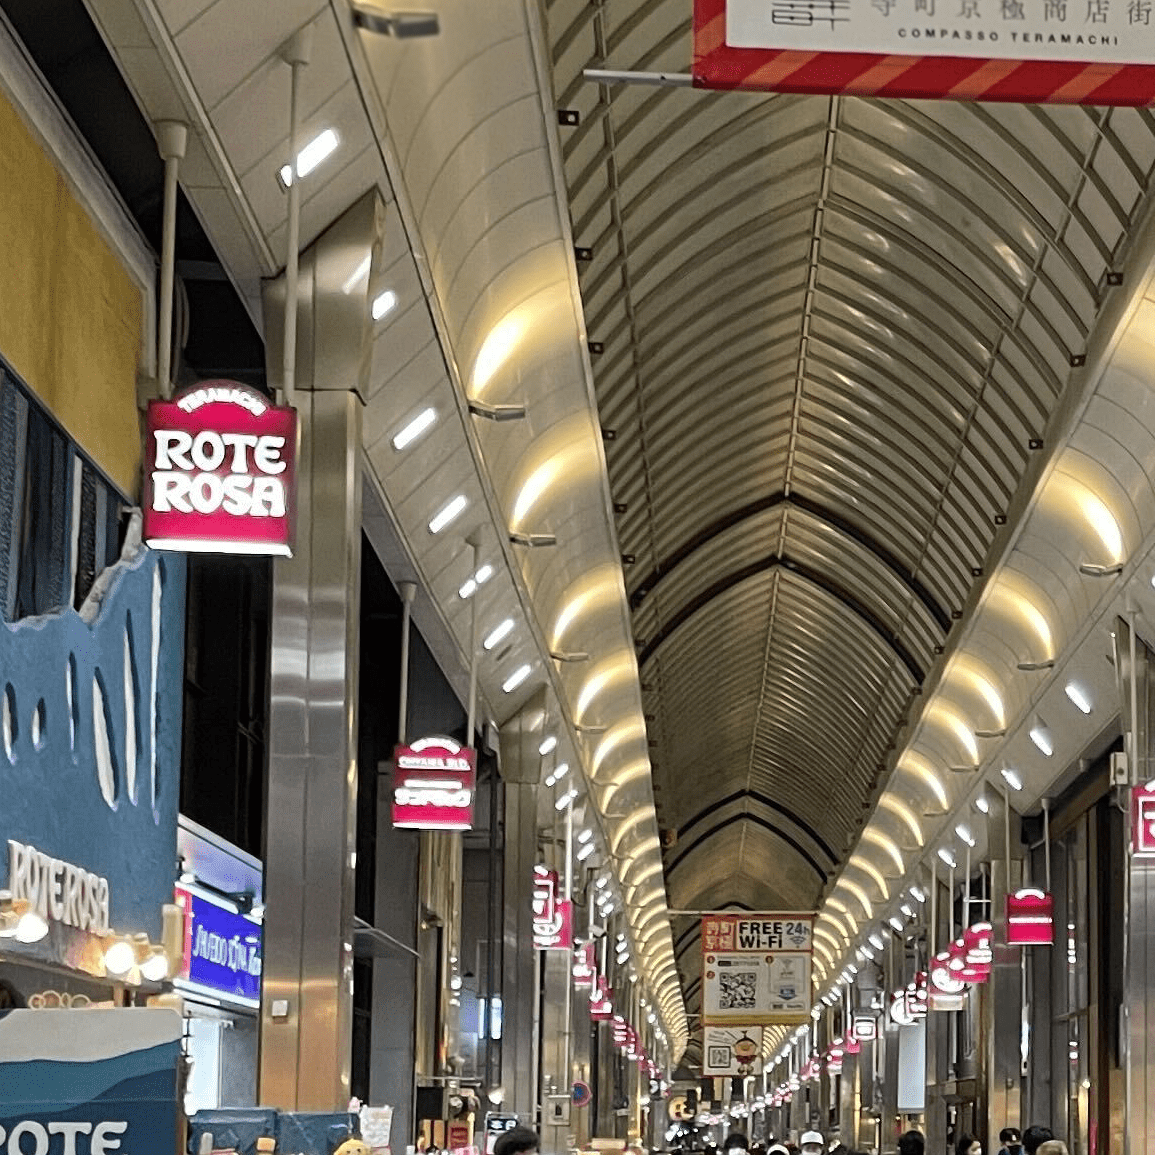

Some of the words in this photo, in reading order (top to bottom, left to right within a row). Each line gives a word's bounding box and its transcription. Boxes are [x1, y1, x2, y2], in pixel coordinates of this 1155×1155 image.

[897, 28, 999, 42] COMPASSO
[1010, 31, 1118, 47] TERAMACHI
[153, 429, 287, 475] ROTE
[151, 471, 287, 518] ROSA
[738, 922, 783, 935] FREE
[0, 1121, 128, 1155] OTE
